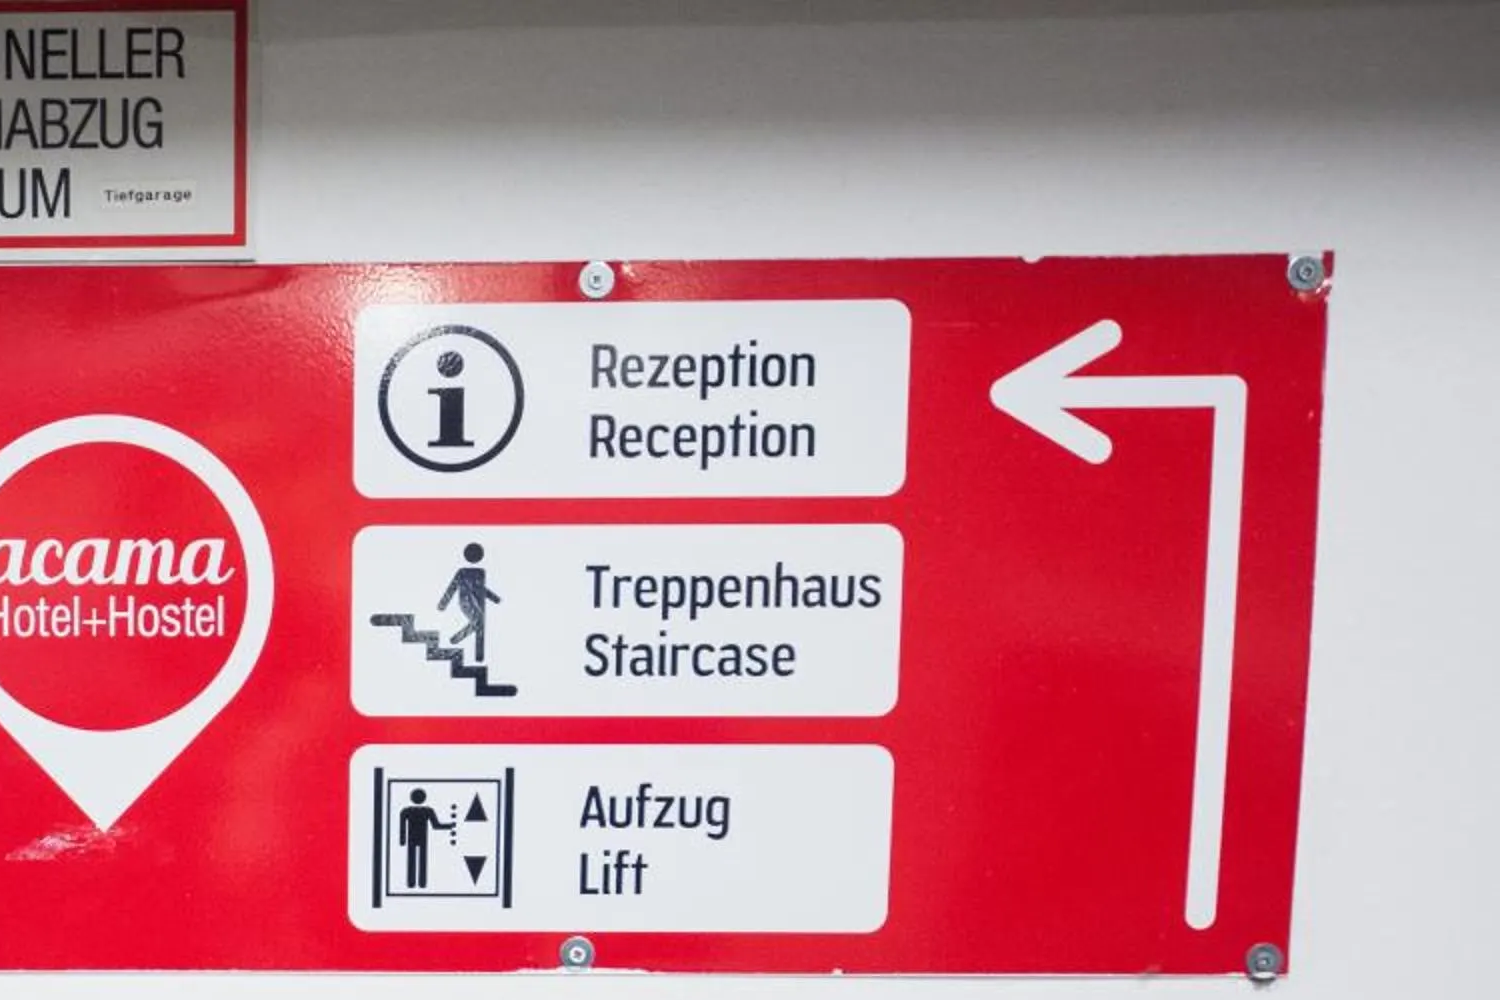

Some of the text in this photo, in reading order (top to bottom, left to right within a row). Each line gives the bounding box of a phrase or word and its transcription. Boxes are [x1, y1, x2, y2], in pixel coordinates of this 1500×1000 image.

[104, 189, 192, 204] Tiefgarage
[591, 340, 816, 400] Rezeption
[589, 410, 816, 470] Reception
[586, 562, 882, 620] Treppenhaus
[583, 630, 796, 678] Staircase
[579, 783, 731, 840] Aufzug
[579, 850, 649, 895] Lift
